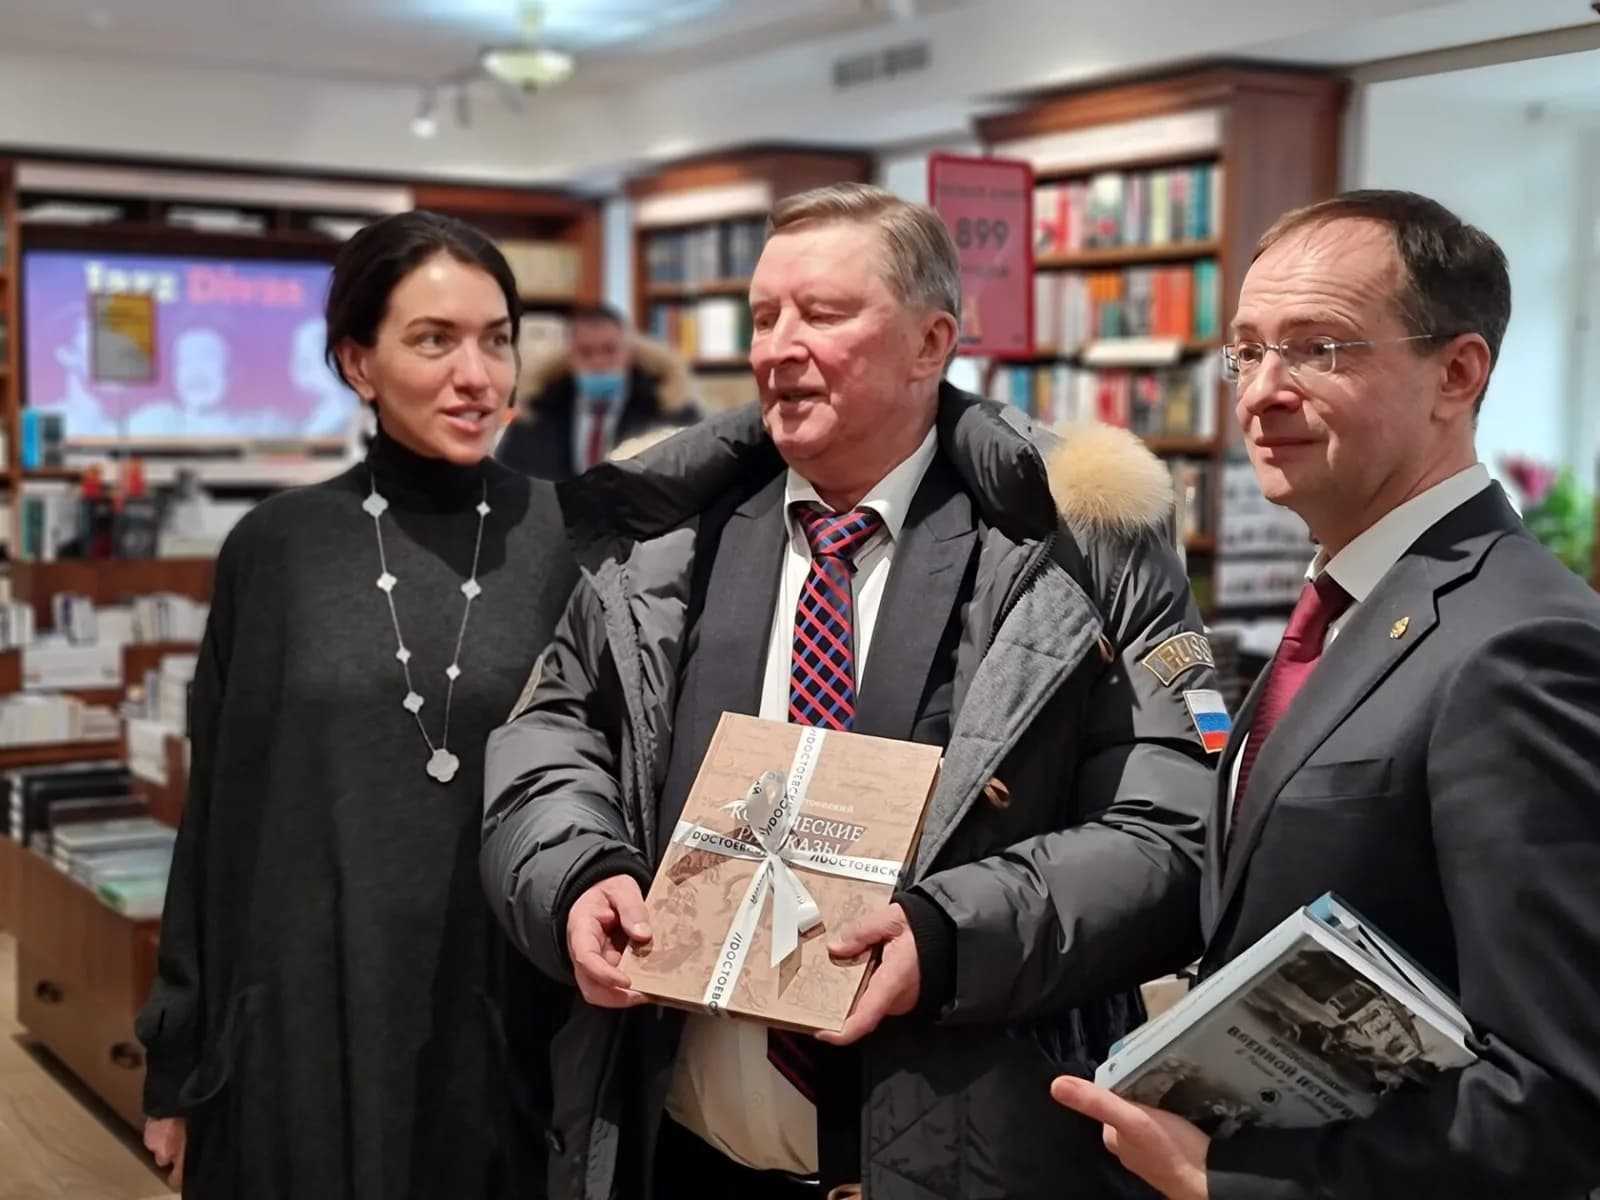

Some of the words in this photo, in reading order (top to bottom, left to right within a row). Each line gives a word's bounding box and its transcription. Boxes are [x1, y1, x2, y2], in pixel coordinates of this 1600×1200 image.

[957, 218, 1008, 247] 899
[1158, 635, 1213, 669] RUSS
[1226, 1025, 1298, 1078] ВОЕННОЙ
[1295, 1076, 1358, 1119] ИСТОРИ
